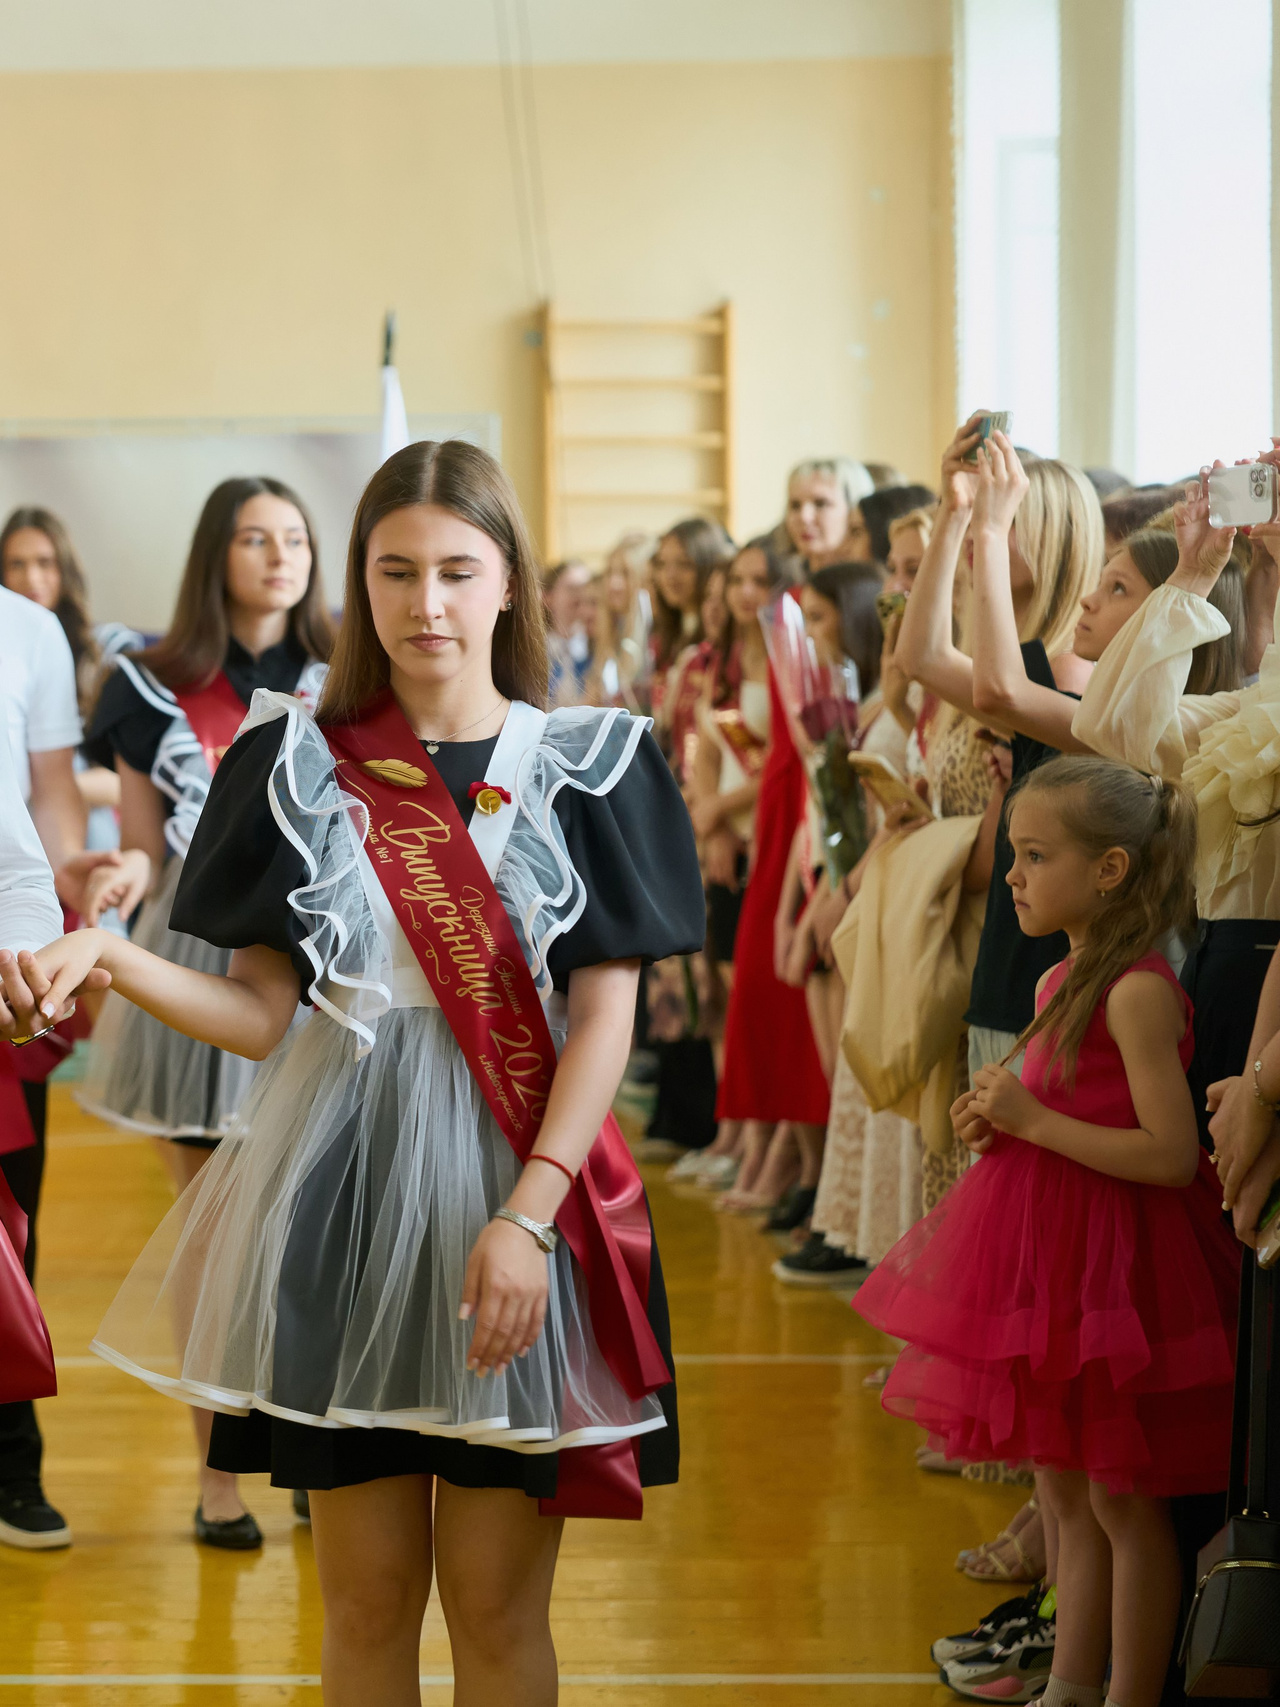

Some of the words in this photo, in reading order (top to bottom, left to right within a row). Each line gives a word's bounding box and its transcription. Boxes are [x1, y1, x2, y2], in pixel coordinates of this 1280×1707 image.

[374, 846, 394, 864] №1
[380, 801, 504, 1017] Выпускница
[460, 885, 500, 957] Дерезина
